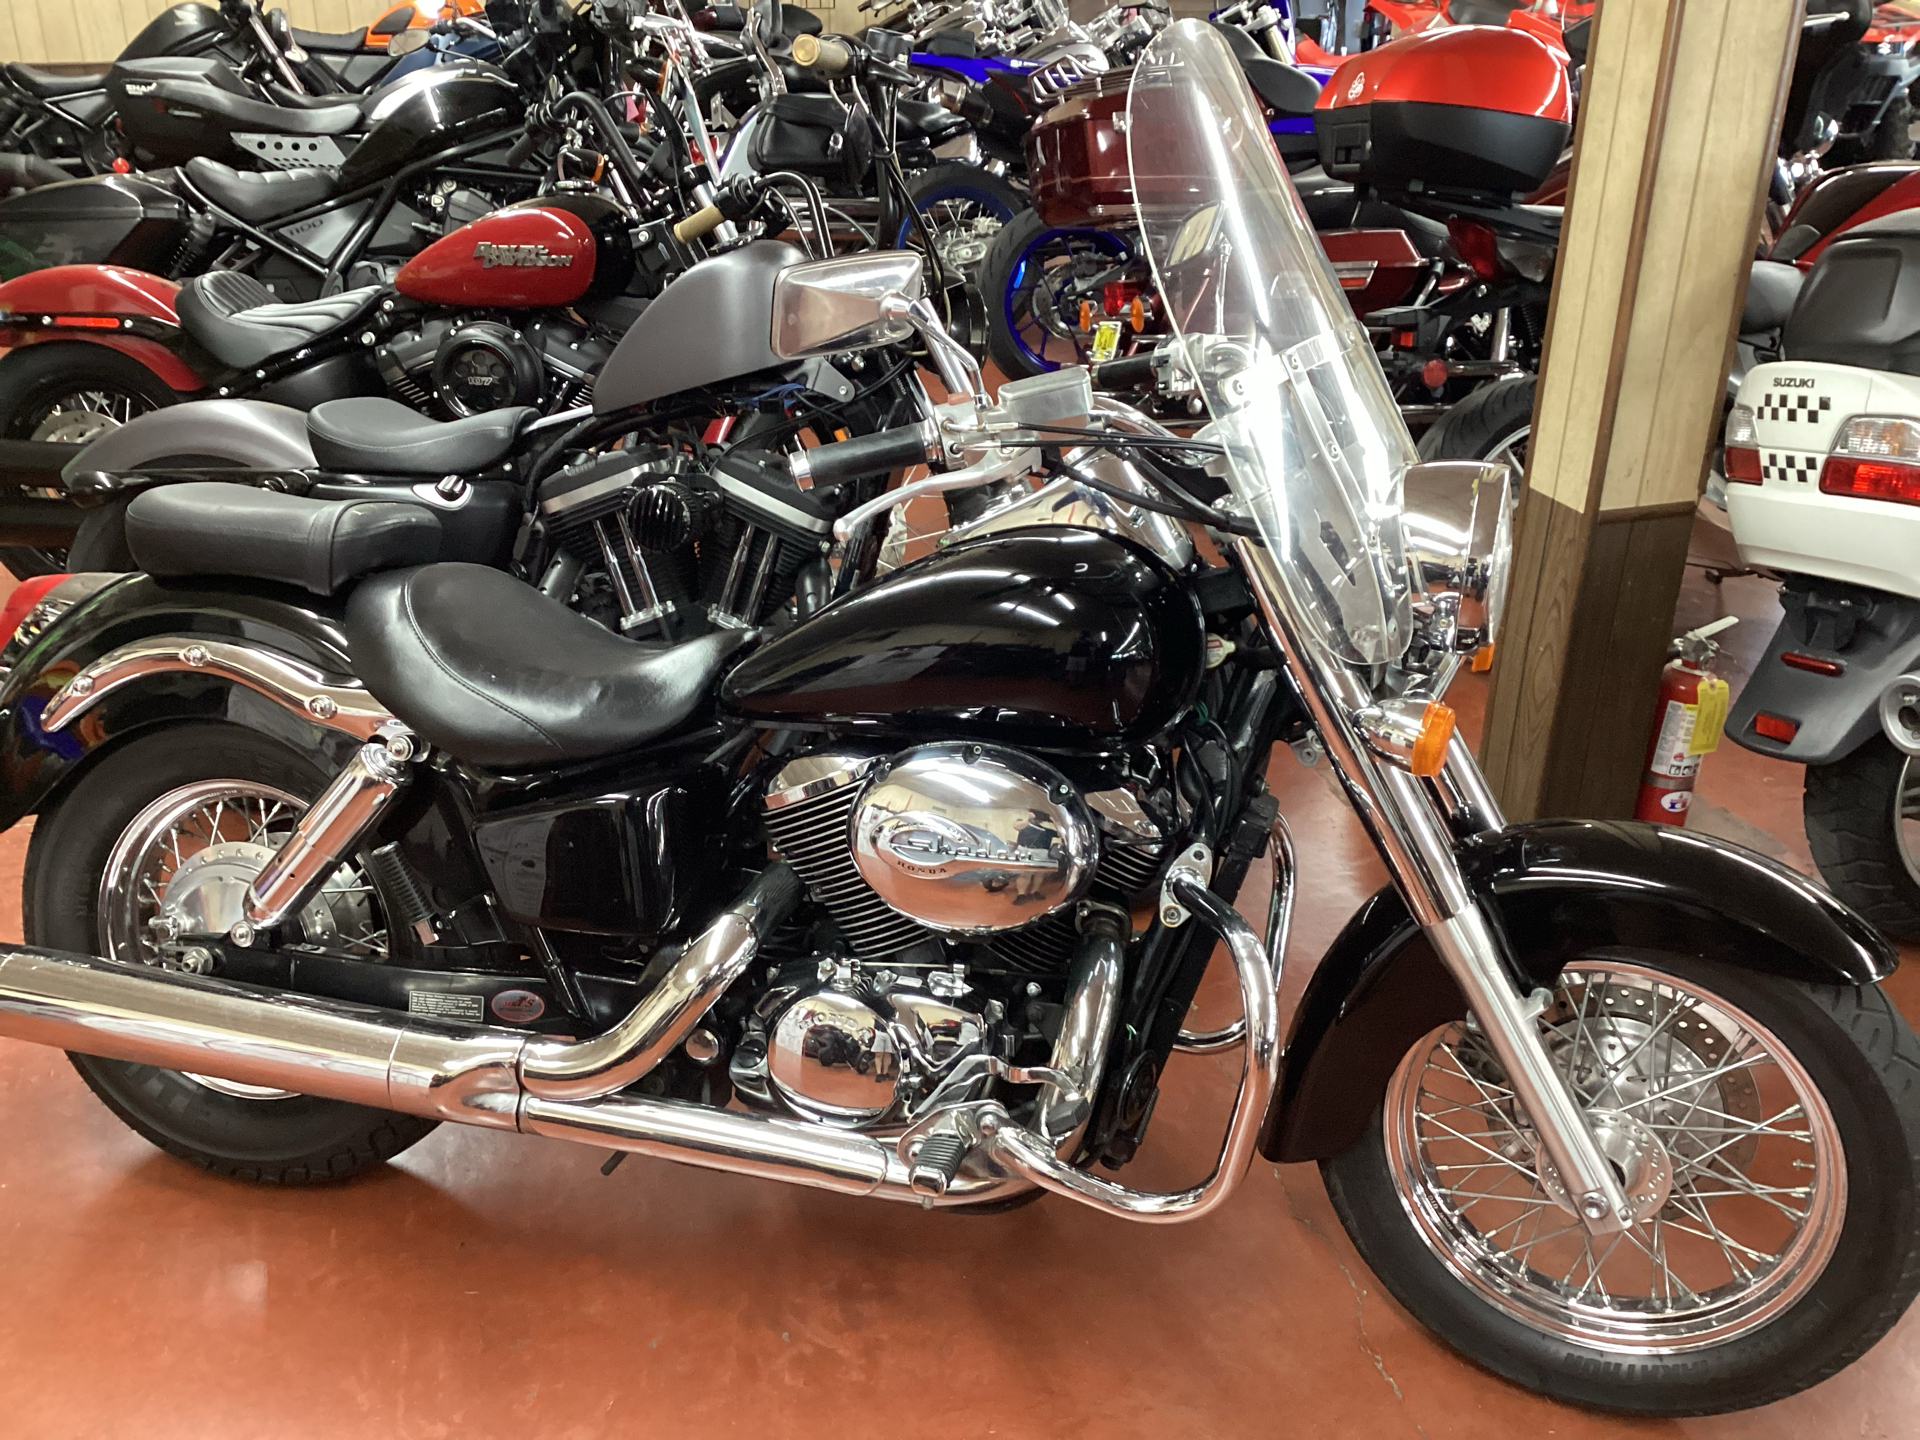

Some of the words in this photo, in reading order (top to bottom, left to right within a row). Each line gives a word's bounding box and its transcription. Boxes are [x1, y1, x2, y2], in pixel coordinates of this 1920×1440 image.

[468, 376, 493, 386] 107
[1773, 377, 1816, 389] SUZUKI
[897, 860, 948, 875] HONDA
